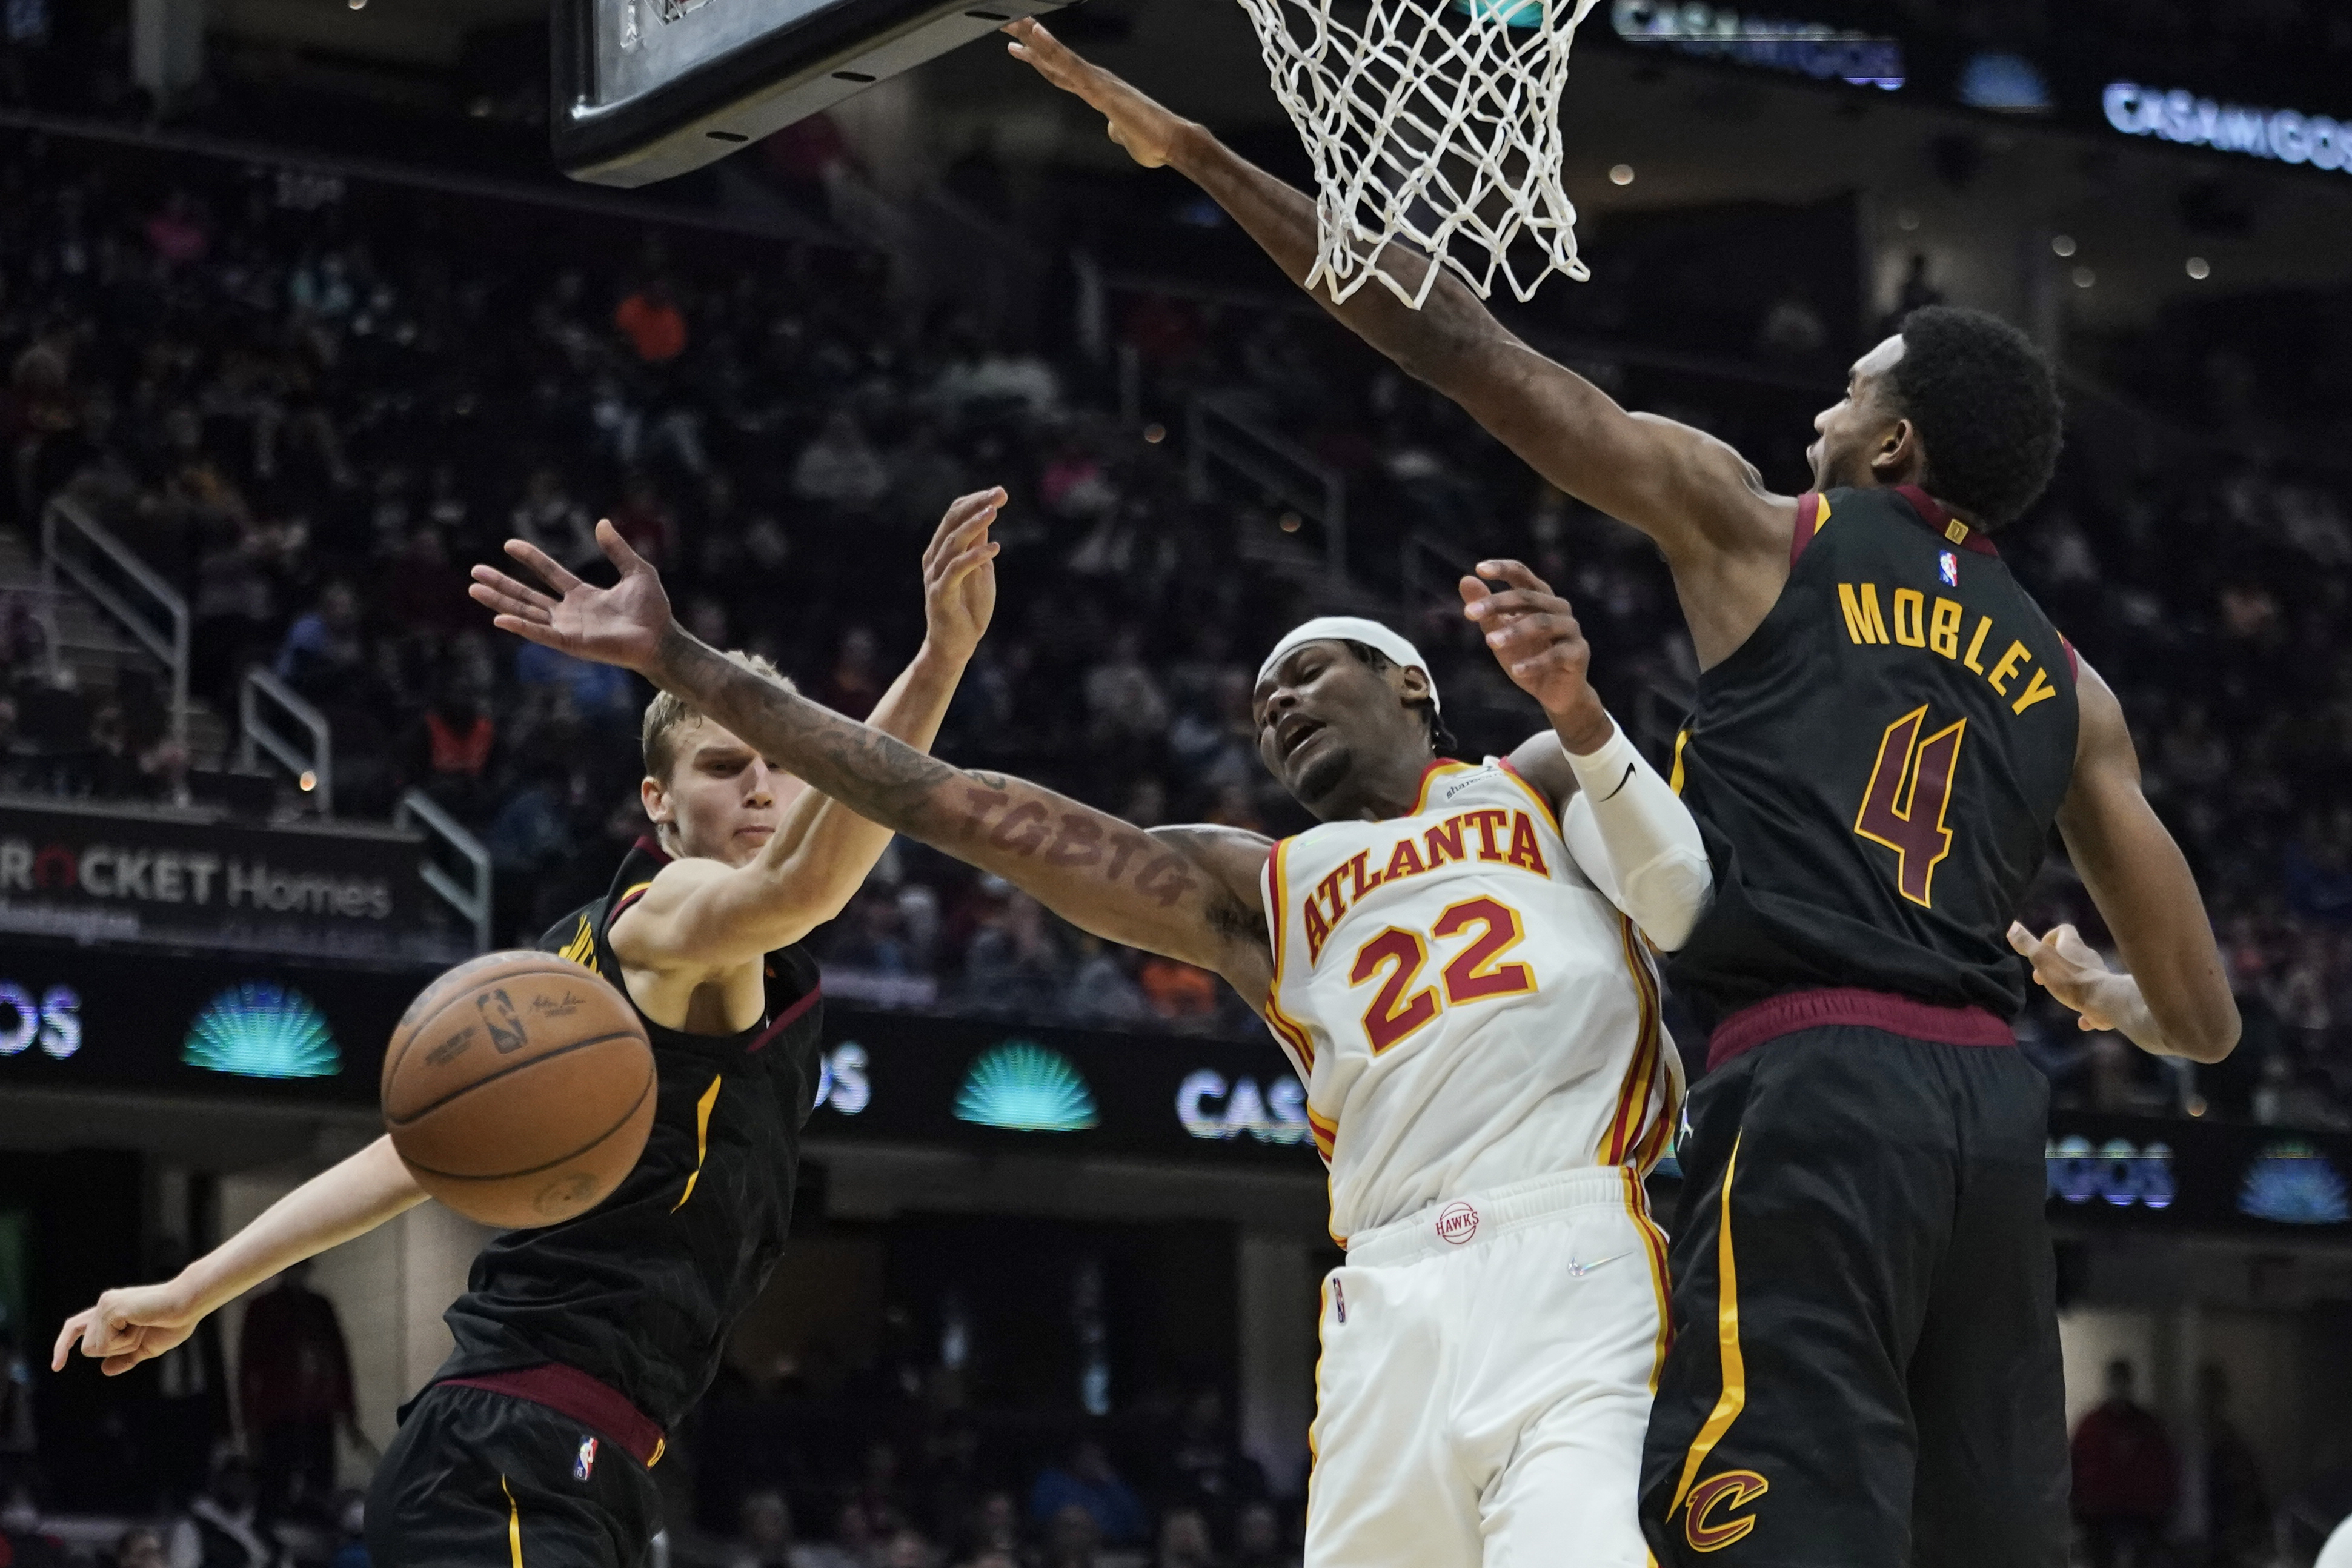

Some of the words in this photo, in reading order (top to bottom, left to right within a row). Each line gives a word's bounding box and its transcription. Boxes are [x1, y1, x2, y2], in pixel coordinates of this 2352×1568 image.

[1837, 583, 2056, 716] MOBLEY
[1853, 703, 1968, 909] 4
[0, 836, 220, 905] ROCKET
[225, 853, 393, 919] Homes
[1304, 809, 1550, 968] ATLANTA
[1349, 894, 1538, 1057] 22
[813, 1040, 871, 1115] S
[1174, 1068, 1316, 1145] CAS
[1435, 1211, 1480, 1236] HAWKS
[1685, 1470, 1769, 1553] C
